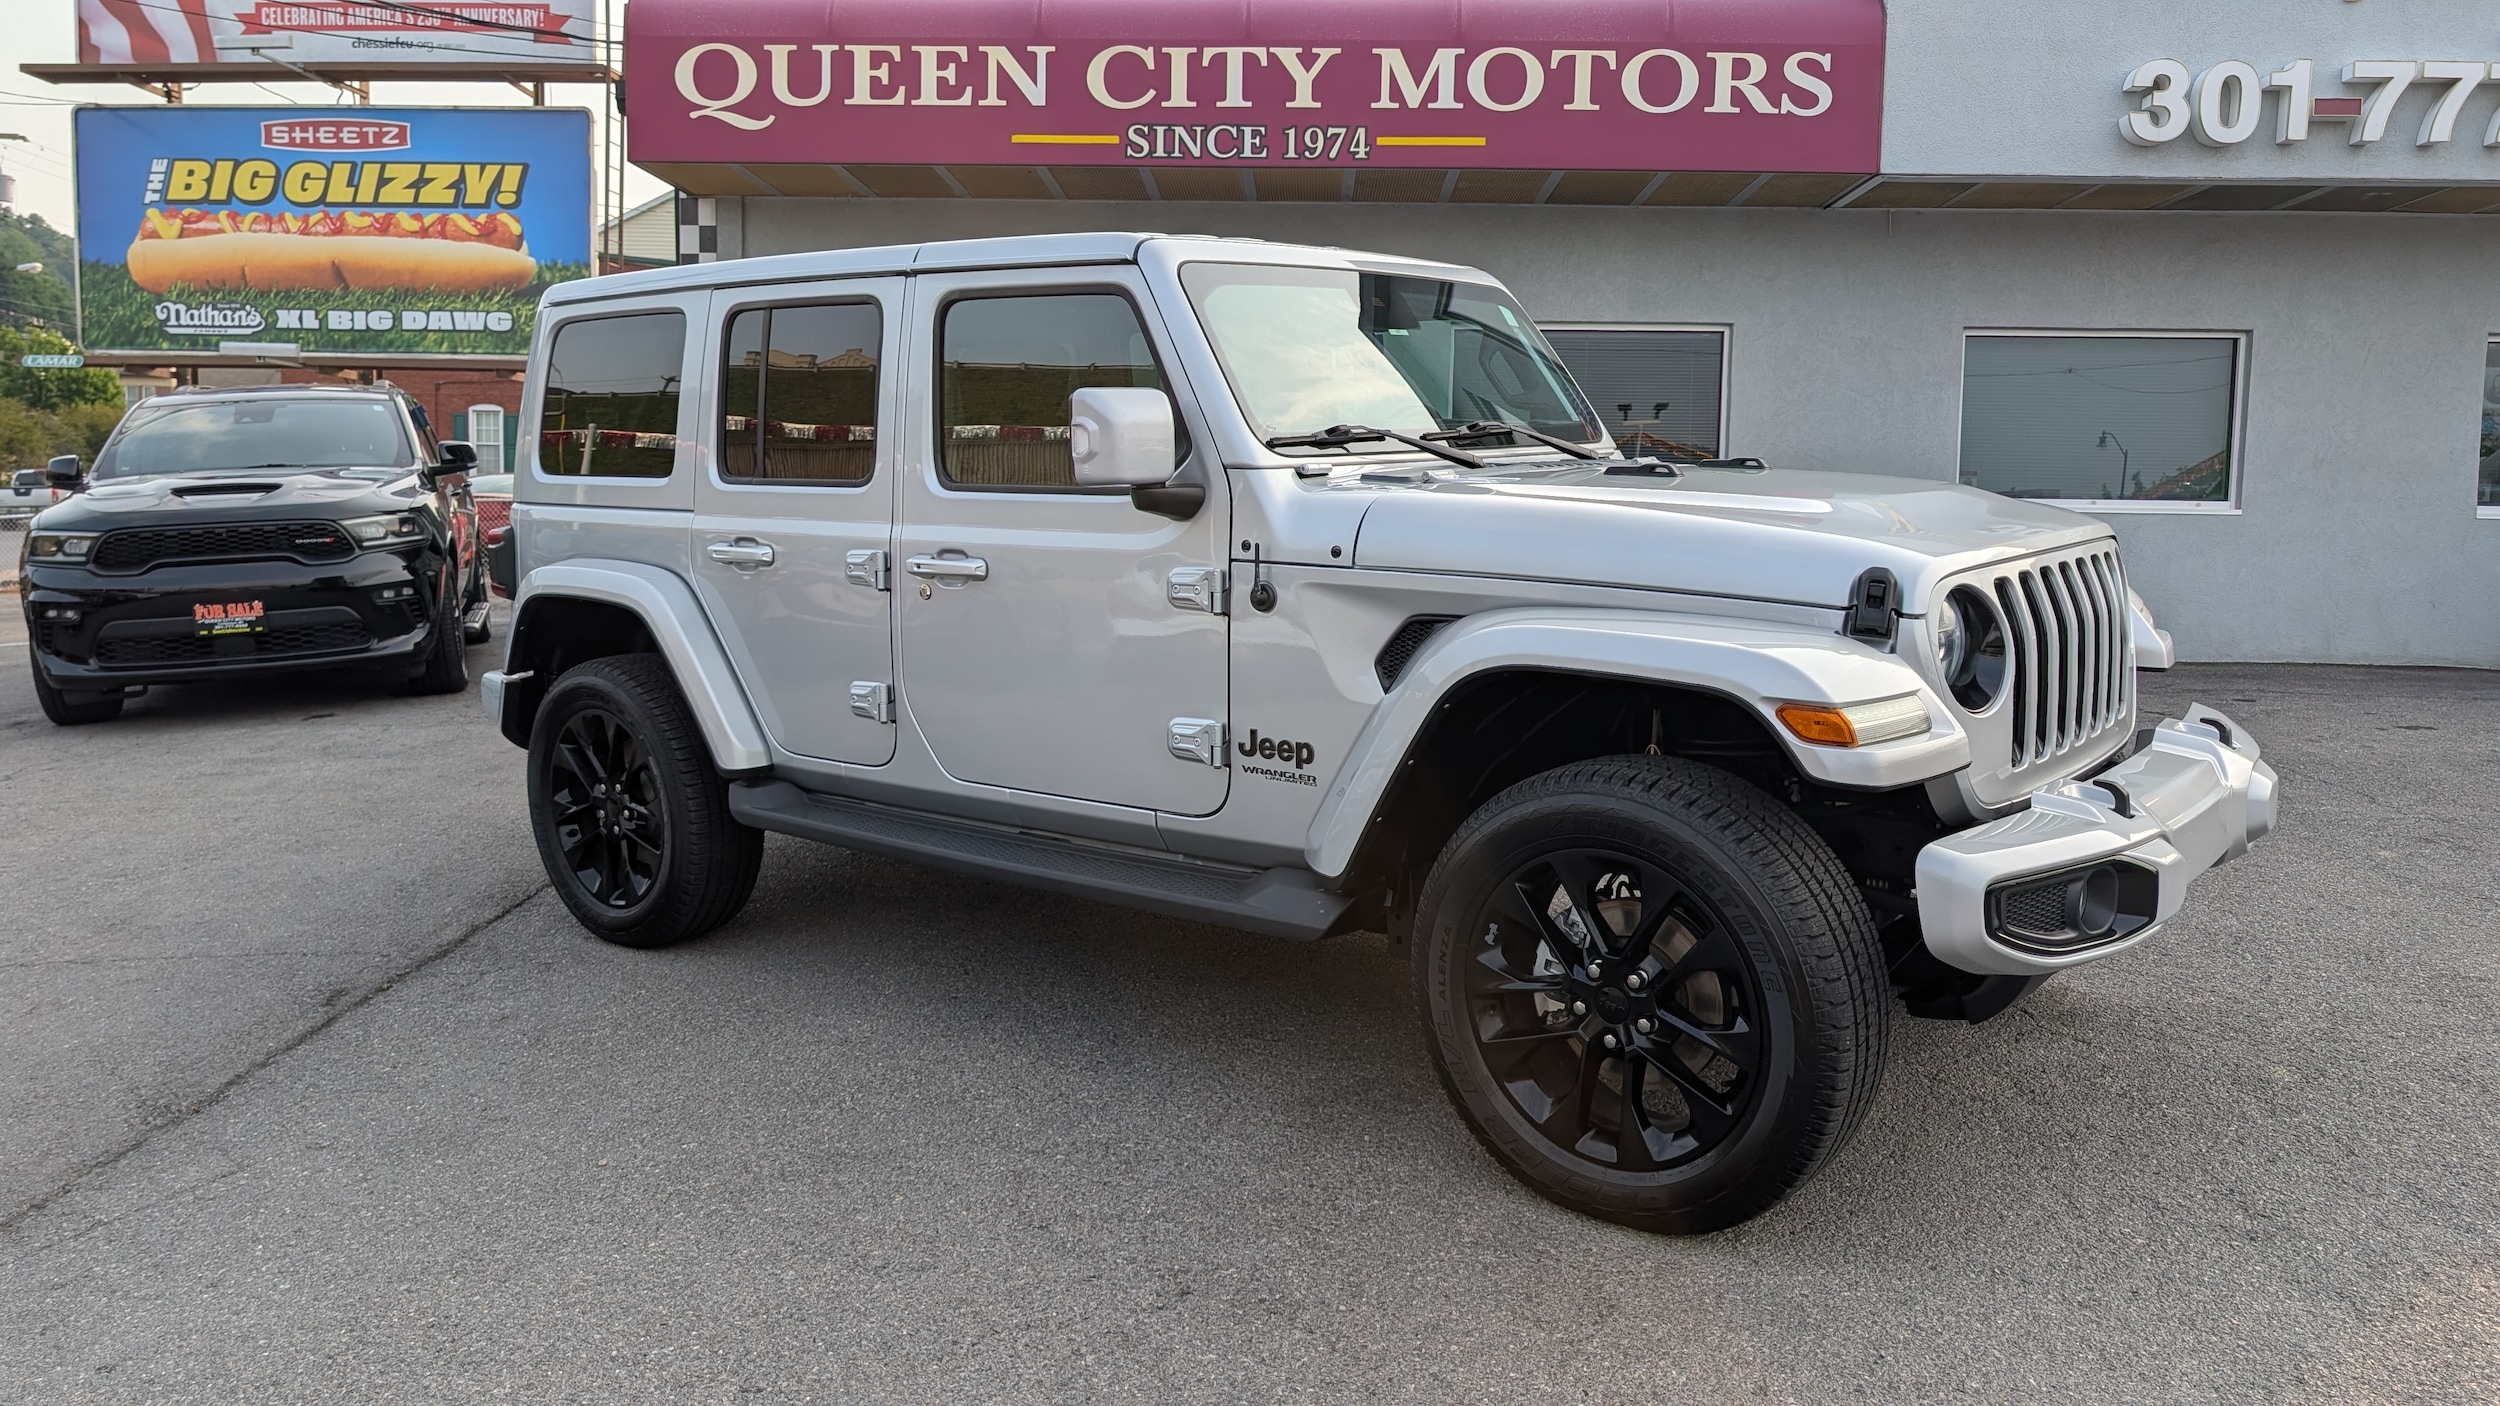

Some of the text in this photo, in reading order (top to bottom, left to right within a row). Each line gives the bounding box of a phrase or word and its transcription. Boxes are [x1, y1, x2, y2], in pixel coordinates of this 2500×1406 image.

[261, 7, 344, 26] CELEBRATING
[454, 8, 544, 28] ANNIVERSARY!
[674, 43, 1833, 130] QUEEN CITY MOTORS
[2118, 58, 2500, 147] 301-77
[271, 126, 401, 145] SHEETZ
[1125, 123, 1371, 160] SINCE 1974
[144, 158, 525, 207] THE BIG GLIZZY!
[155, 301, 513, 332] Nathan's XL BIG DAWG
[27, 355, 78, 366] LAMAR
[194, 600, 264, 620] FOR SALE
[1238, 728, 1315, 770] Jeep
[1241, 765, 1317, 783] WRANGLER
[1265, 775, 1318, 787] UNLIMITED
[1549, 811, 1785, 996] BRIDGESTONE
[1439, 924, 1454, 1004] ALENZA
